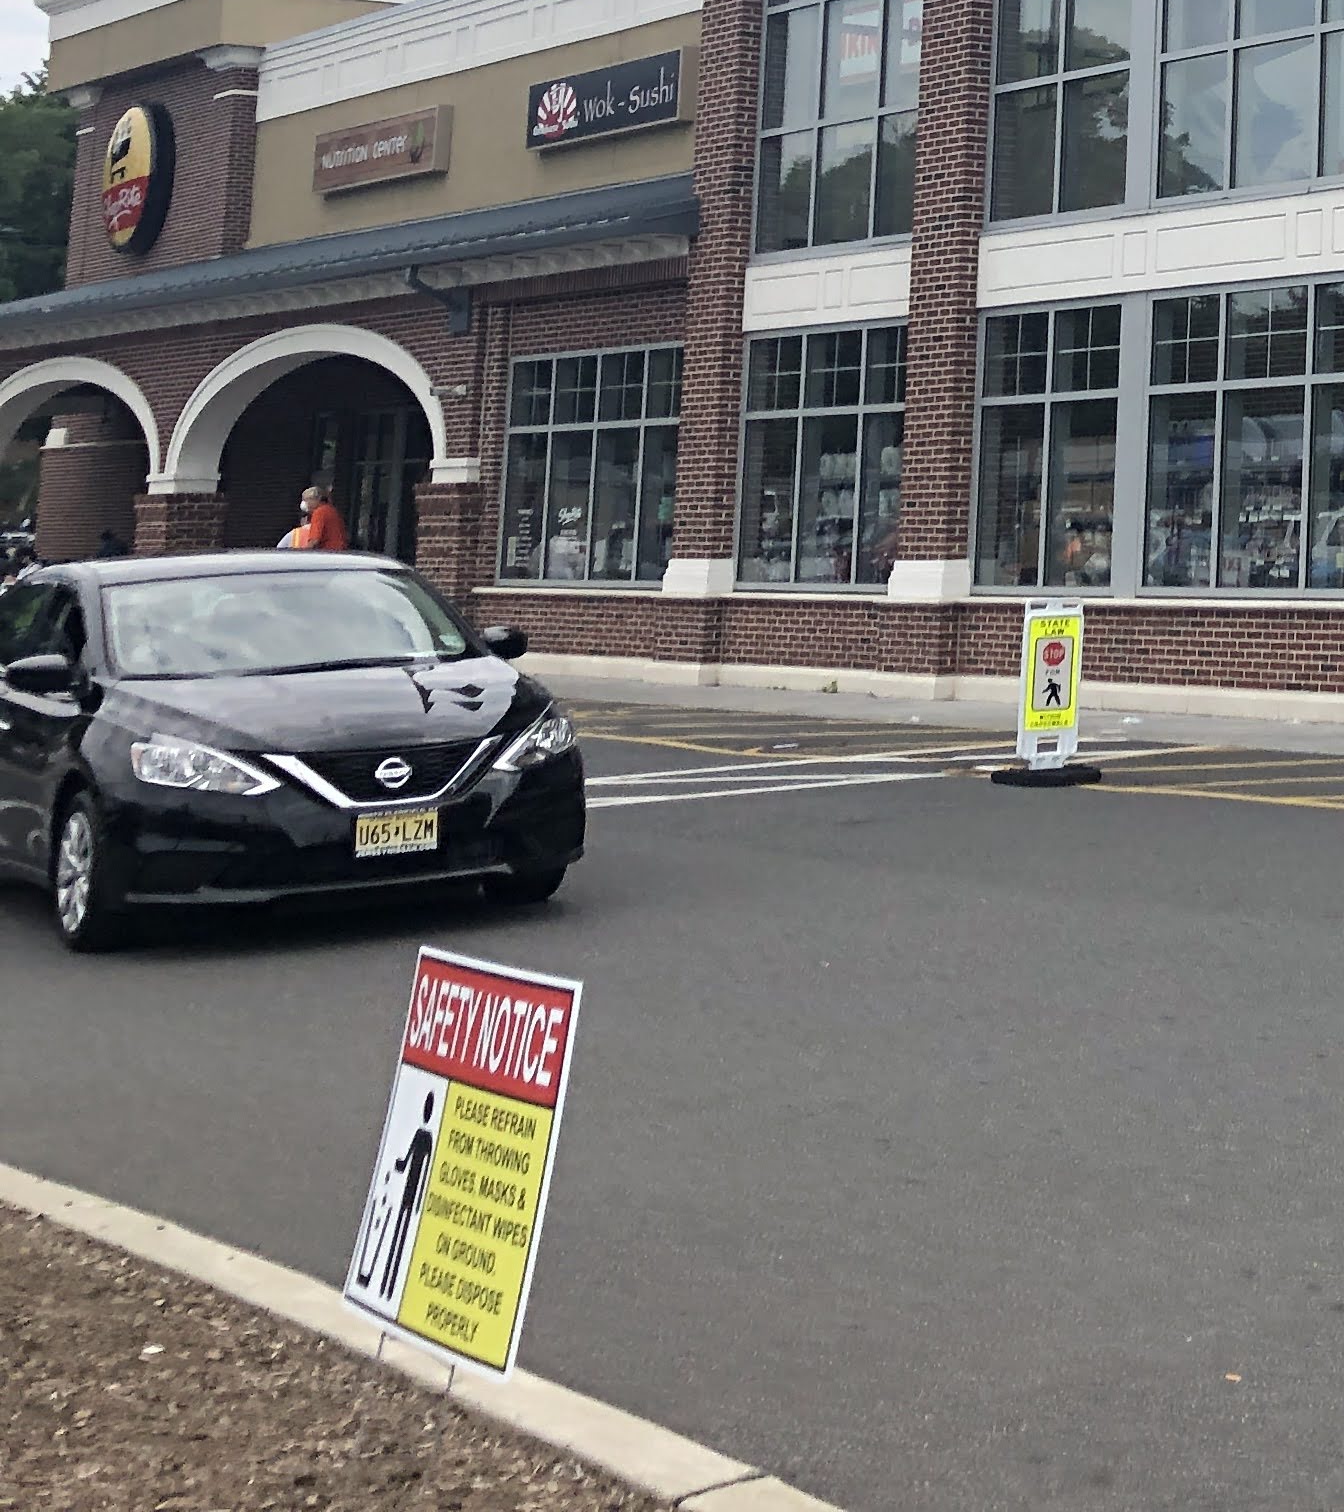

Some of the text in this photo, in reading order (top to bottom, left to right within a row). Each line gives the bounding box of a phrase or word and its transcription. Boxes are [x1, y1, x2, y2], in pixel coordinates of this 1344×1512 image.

[584, 80, 614, 123] Wok
[628, 66, 675, 114] Sushi
[1040, 619, 1070, 628] STATE
[1044, 628, 1064, 636] LAW
[1043, 648, 1065, 660] STOP
[410, 974, 565, 1087] SAFETY NOTICE
[454, 1096, 537, 1140] PLEASE REFRAIN
[448, 1129, 531, 1175] FROM THROWING
[479, 1175, 516, 1207] MASKS
[517, 1187, 527, 1211] &
[426, 1192, 529, 1248] DISINFECTANT WIPES
[435, 1232, 452, 1256] ON
[418, 1261, 504, 1316] PLEASE DISPOSE
[425, 1301, 480, 1343] PROPERLY
